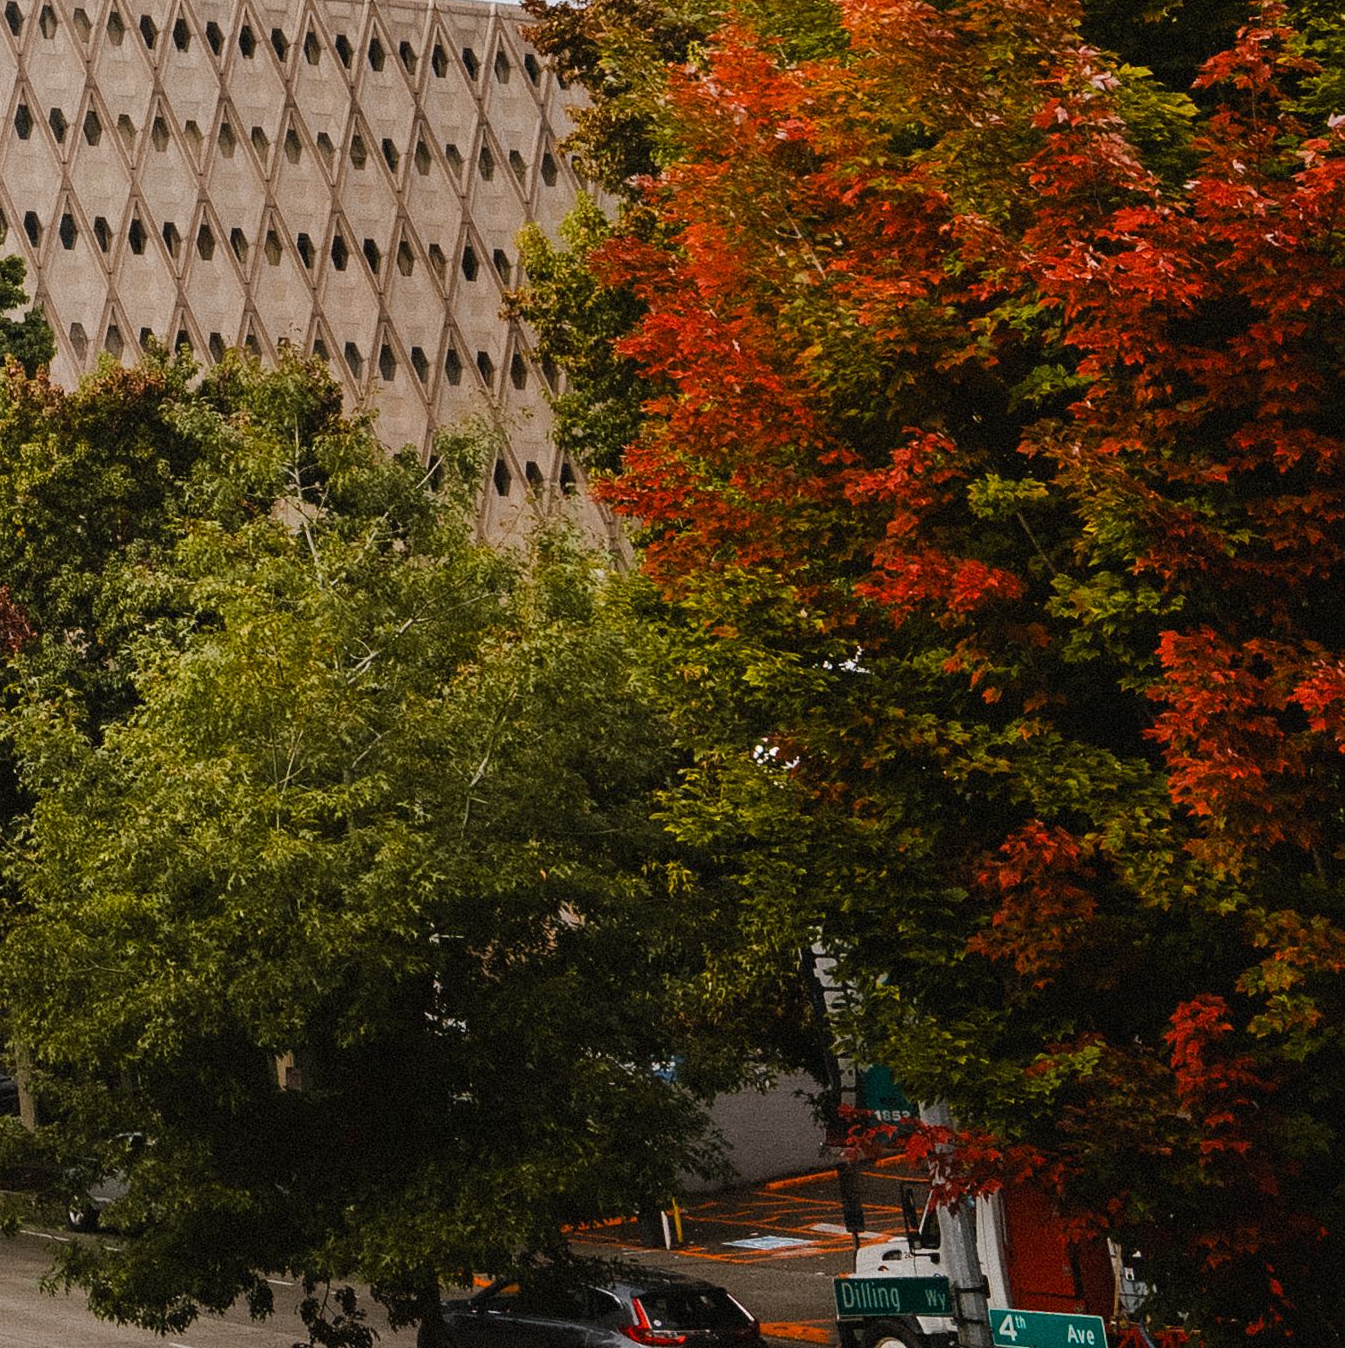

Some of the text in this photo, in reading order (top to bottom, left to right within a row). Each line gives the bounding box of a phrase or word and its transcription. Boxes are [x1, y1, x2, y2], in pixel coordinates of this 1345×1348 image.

[840, 1282, 946, 1312] Dilling Wy
[998, 1314, 1096, 1345] 4th Ave
